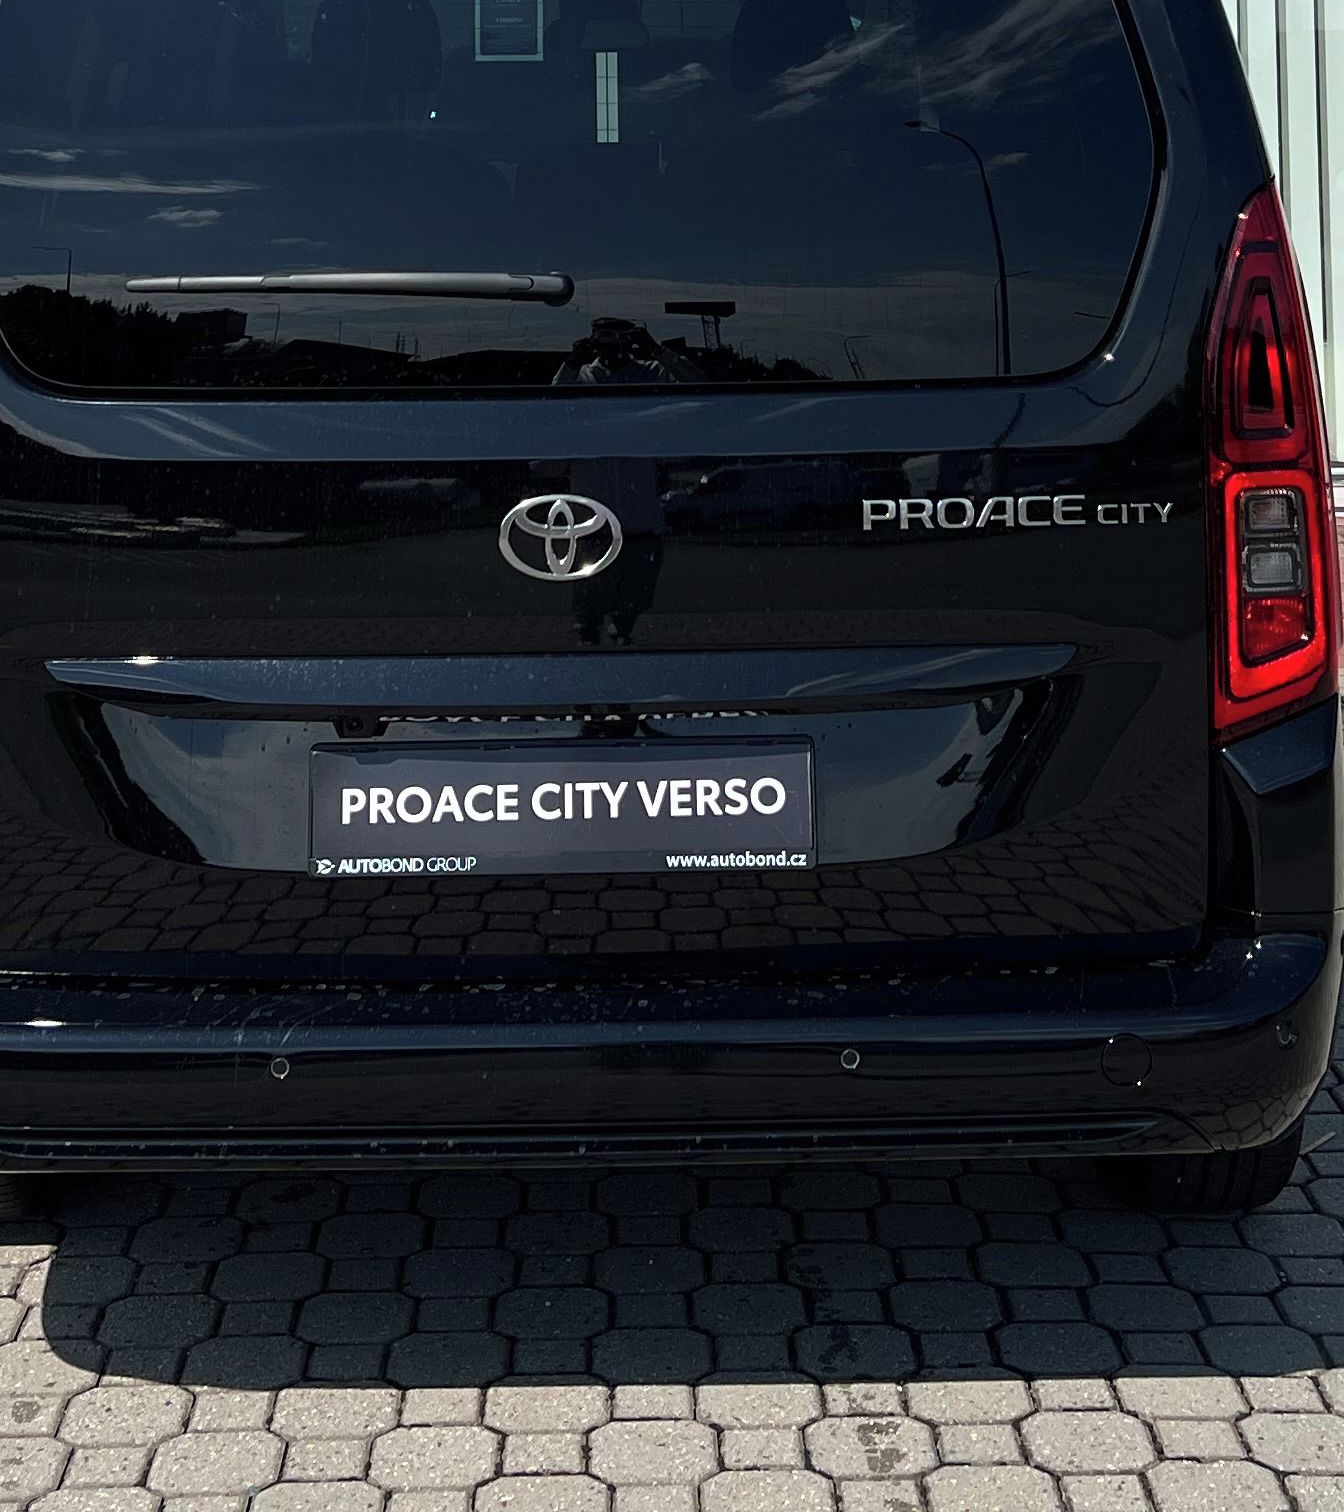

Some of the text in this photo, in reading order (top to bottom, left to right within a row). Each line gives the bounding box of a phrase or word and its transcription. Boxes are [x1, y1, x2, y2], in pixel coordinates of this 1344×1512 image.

[861, 493, 1175, 532] PROACE CITY
[341, 777, 787, 825] PROACE CITY VERSO
[337, 856, 477, 874] AUTOBOND GROUP
[665, 850, 808, 868] www.autobond.cz
